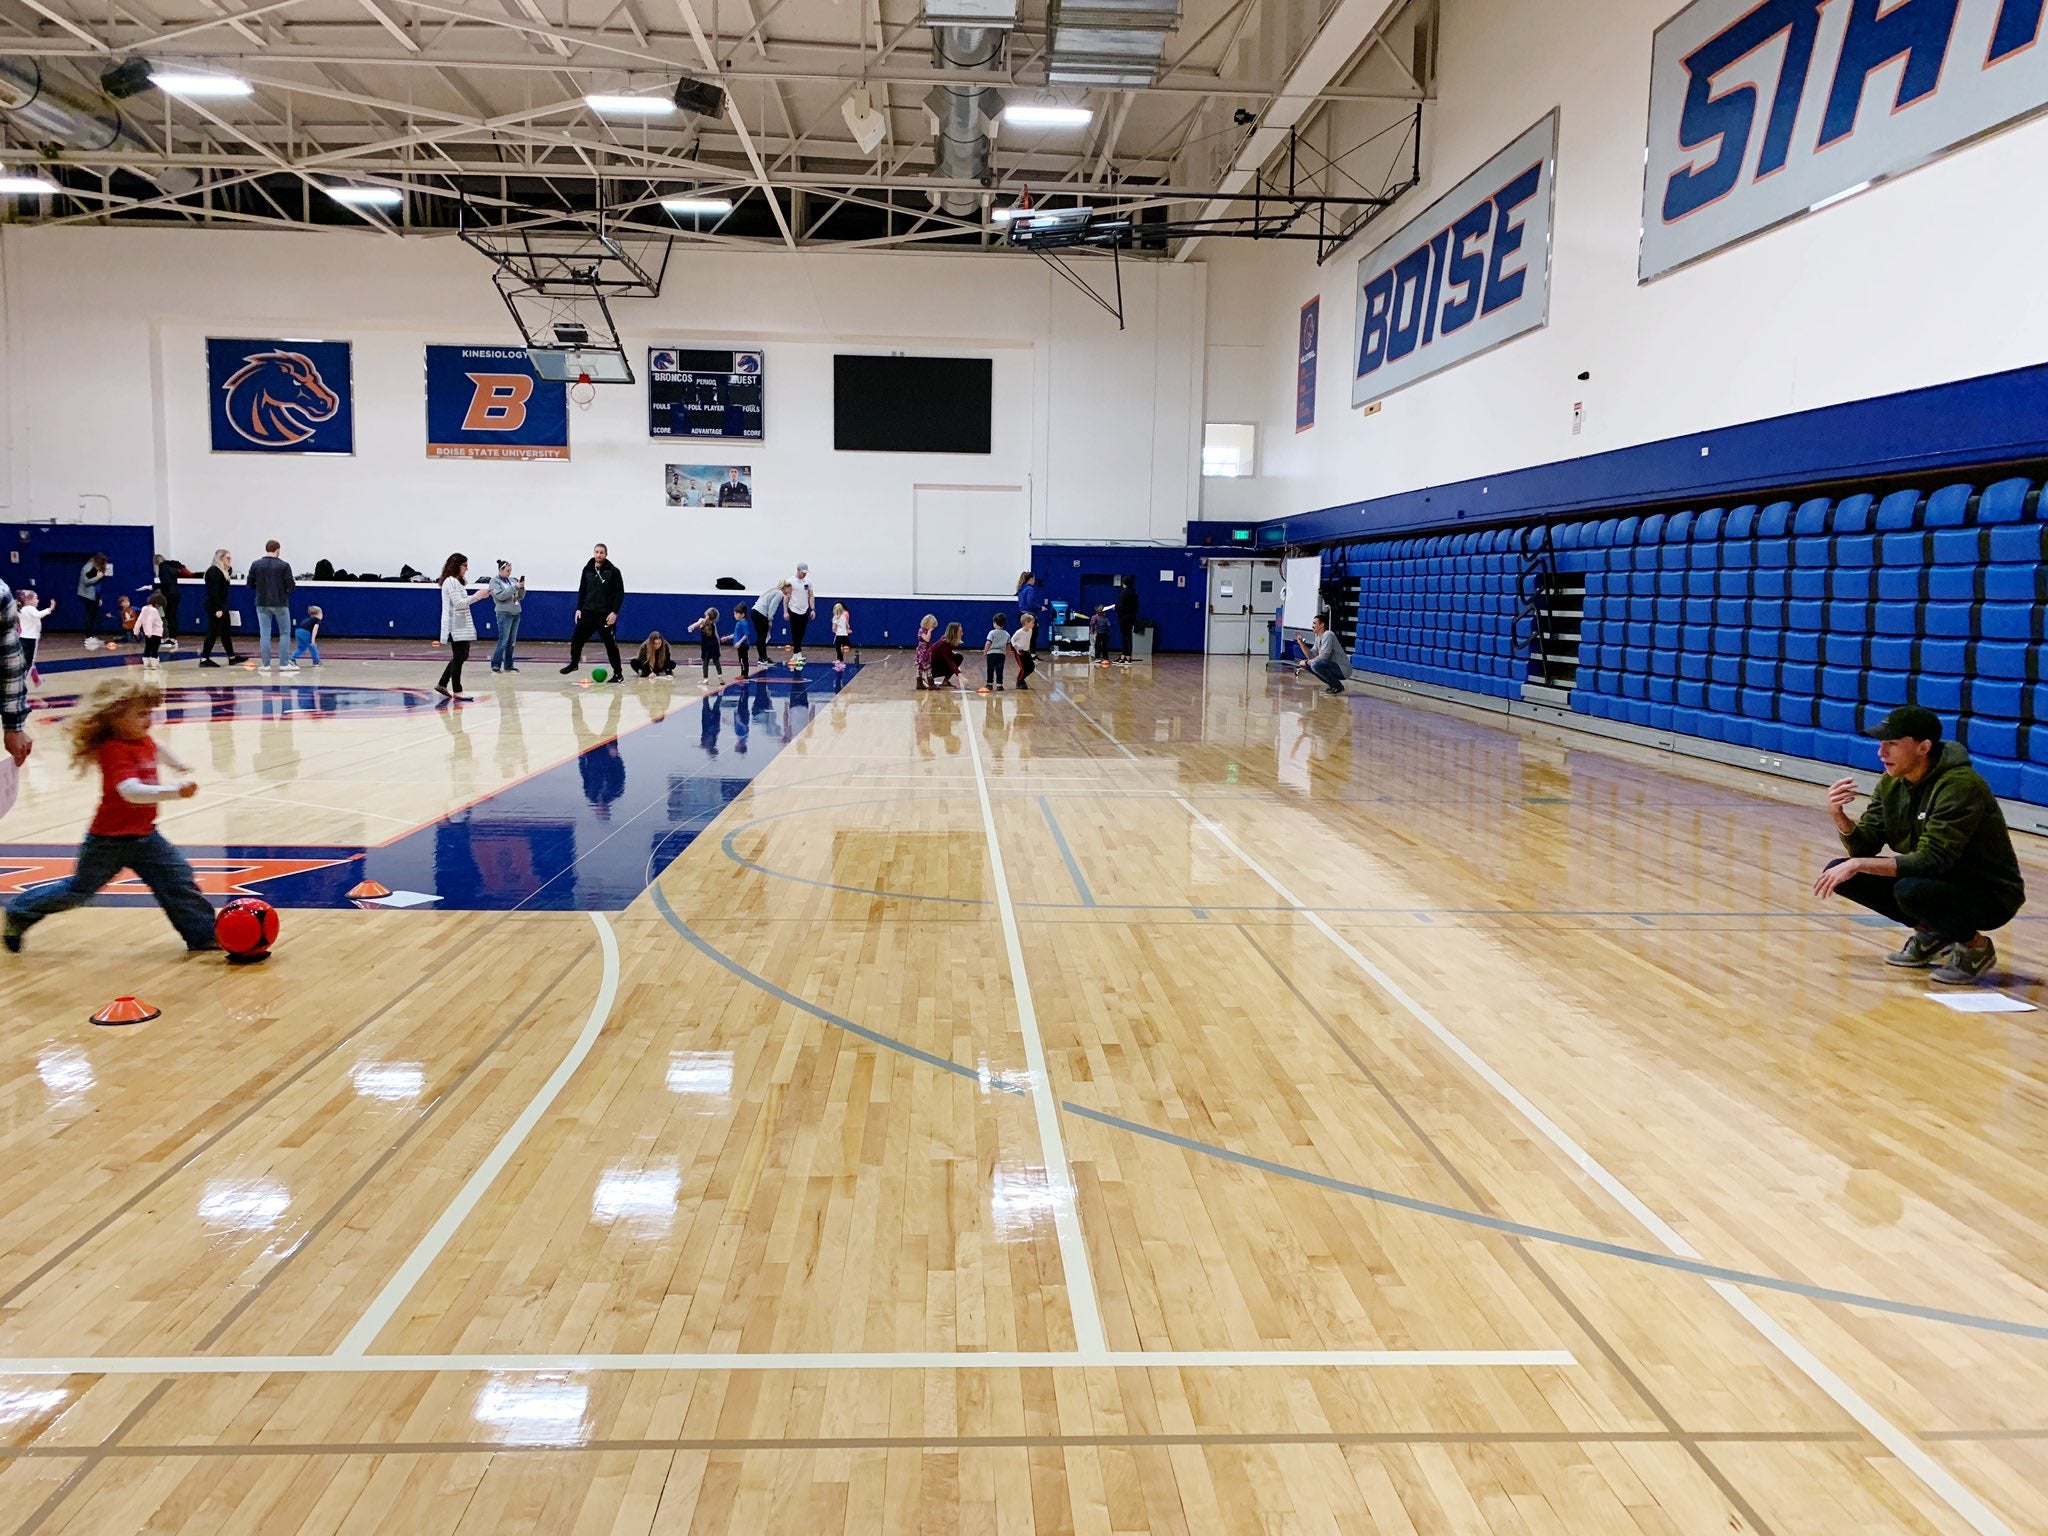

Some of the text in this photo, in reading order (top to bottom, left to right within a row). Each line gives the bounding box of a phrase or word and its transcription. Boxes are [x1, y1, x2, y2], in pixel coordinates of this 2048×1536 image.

[1356, 157, 1545, 382] BOISE
[462, 350, 528, 359] KINESIOLOGY
[654, 373, 693, 382] BRONCOS
[461, 372, 534, 431] B
[742, 405, 760, 413] FOULS
[743, 429, 761, 437] SCORE
[436, 447, 561, 458] BOISE STATE UNIVERSITY
